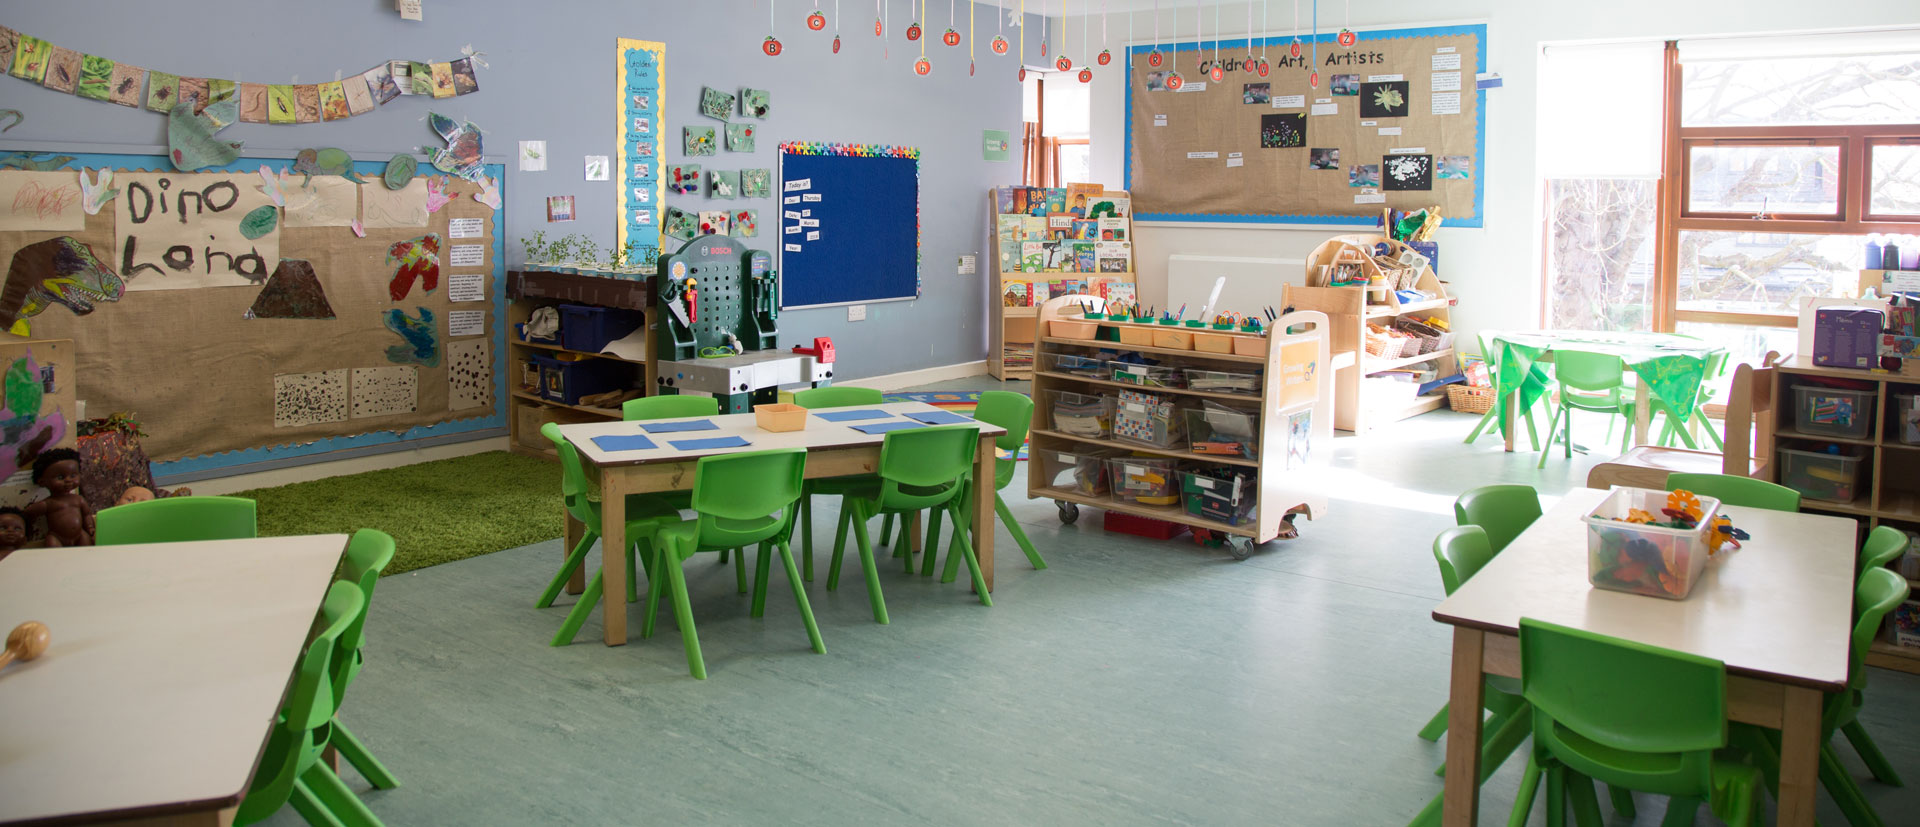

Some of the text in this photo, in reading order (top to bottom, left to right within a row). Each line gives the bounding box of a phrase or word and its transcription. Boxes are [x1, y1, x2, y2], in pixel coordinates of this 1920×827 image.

[1344, 35, 1350, 43] Z
[769, 44, 776, 53] B
[1325, 51, 1384, 66] Artists
[1060, 61, 1068, 69] N
[128, 178, 240, 224] Dino
[710, 247, 732, 255] BOSCH
